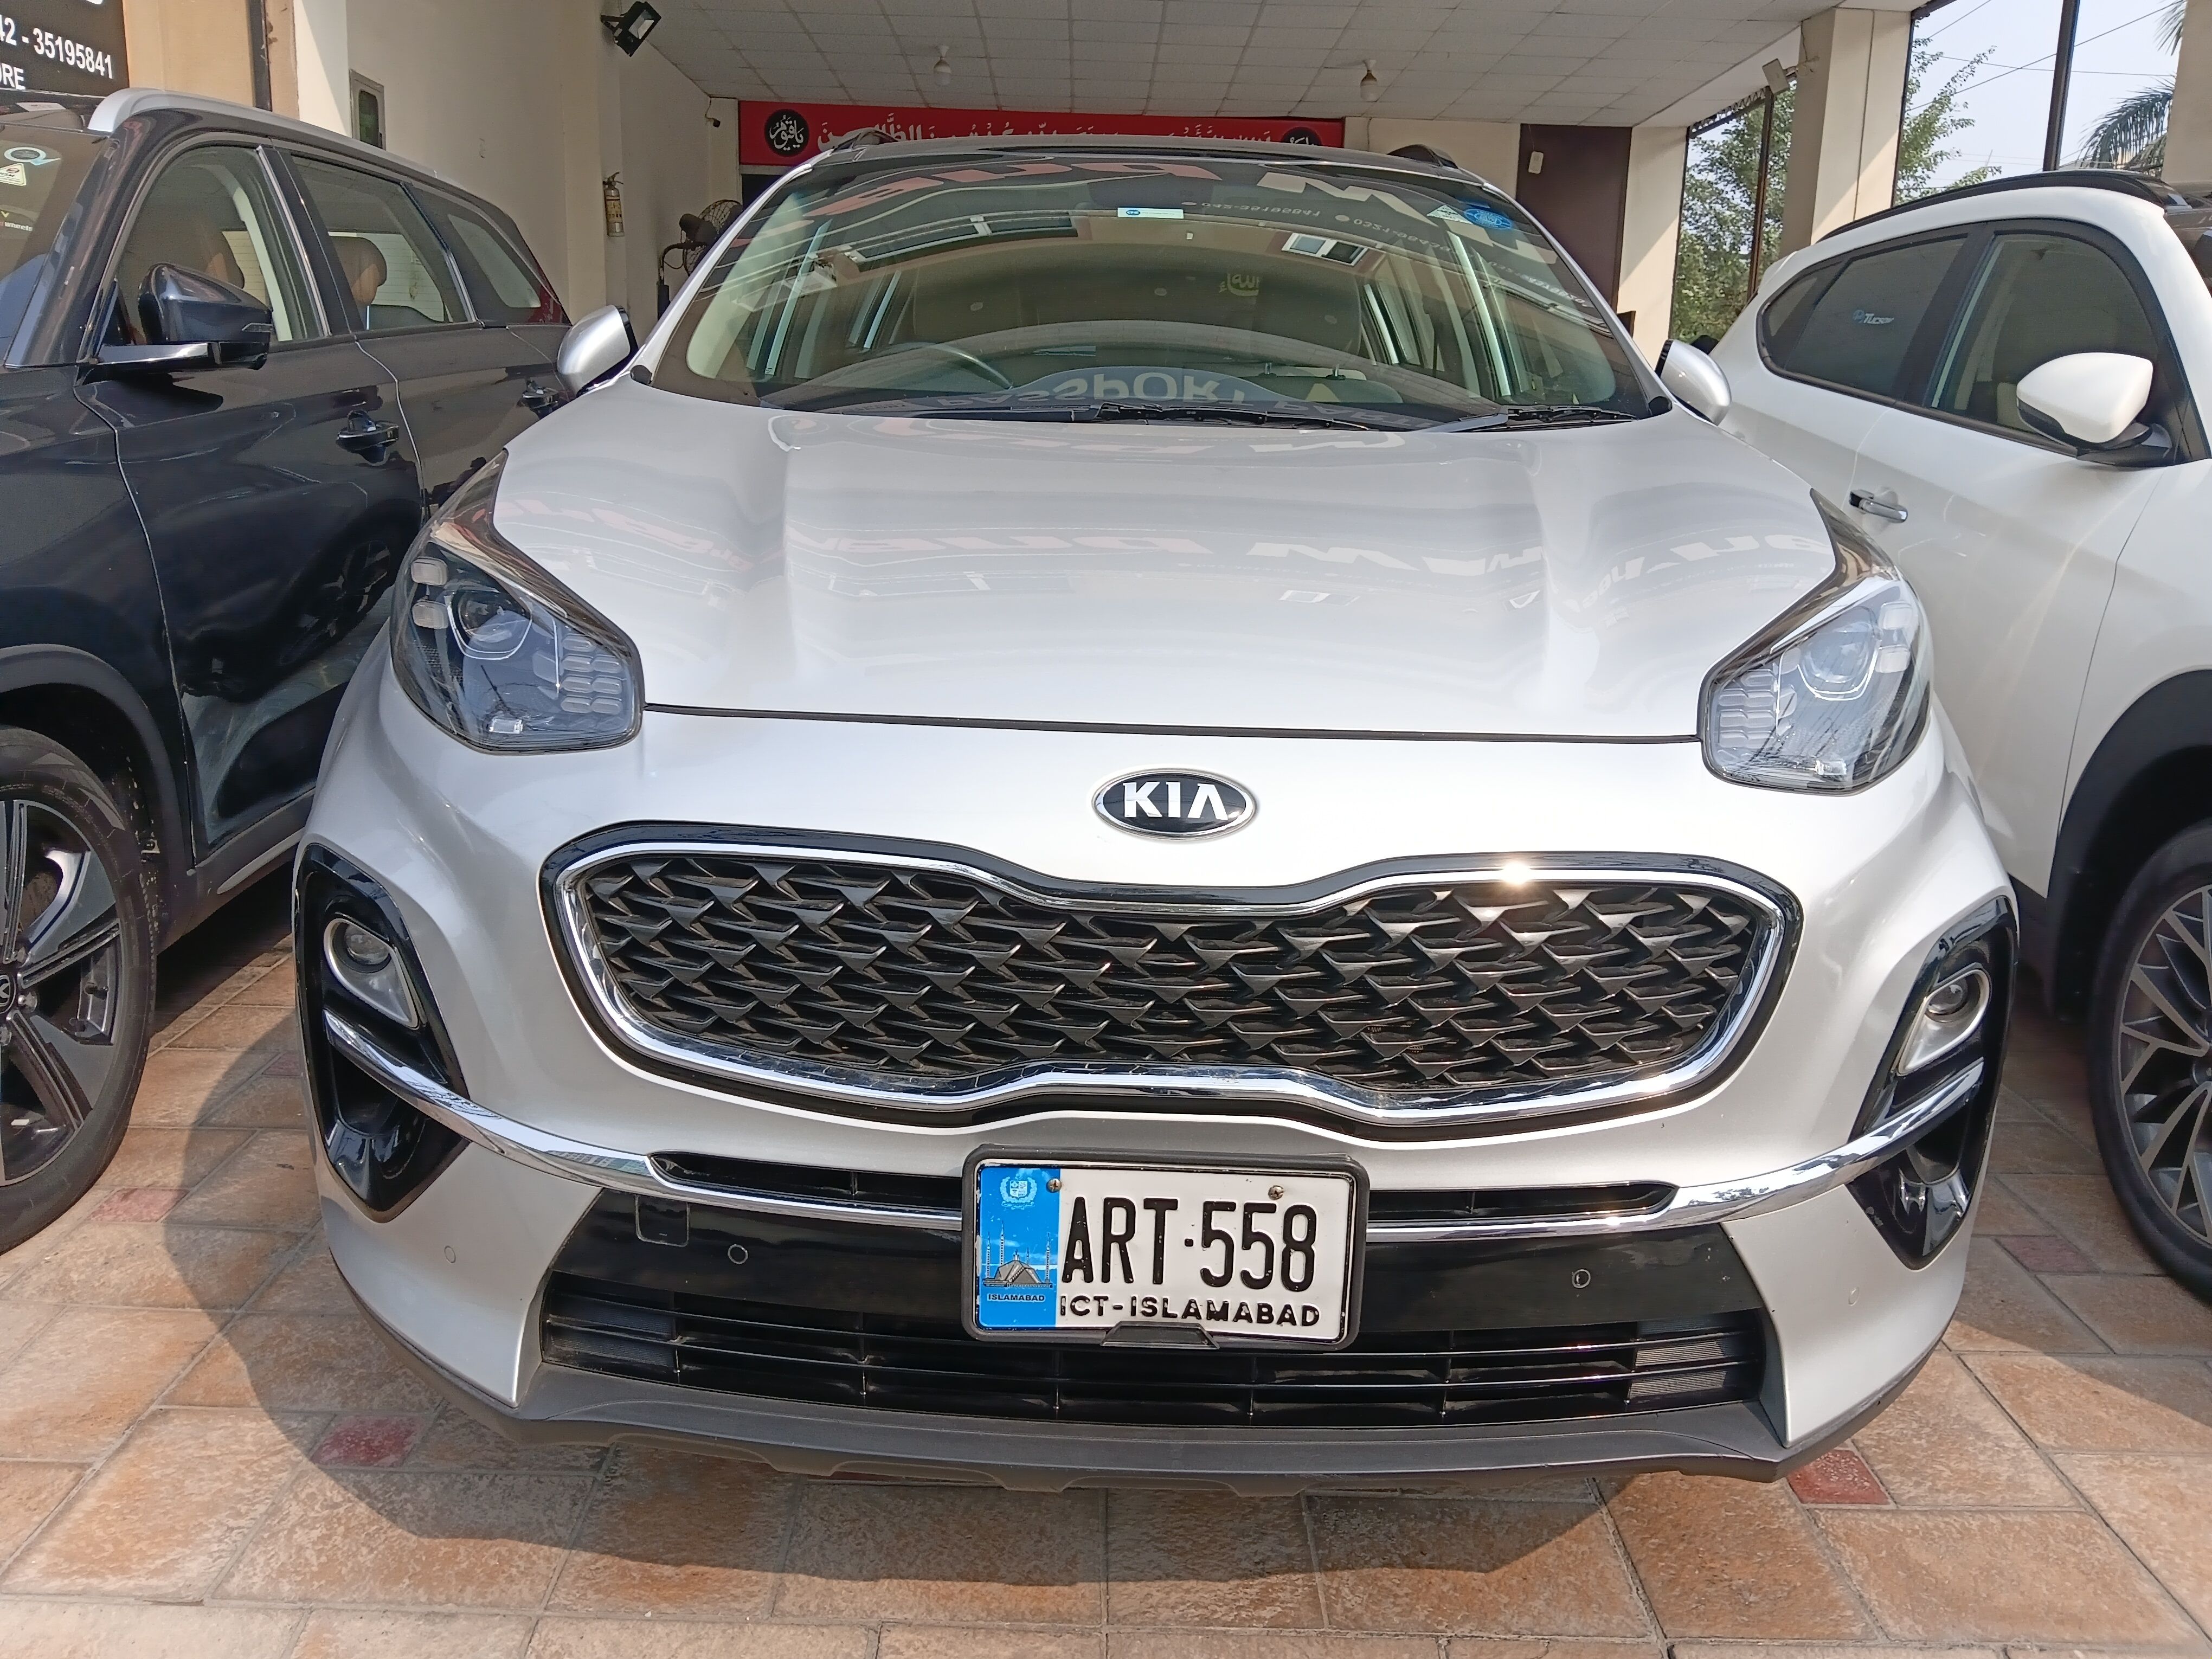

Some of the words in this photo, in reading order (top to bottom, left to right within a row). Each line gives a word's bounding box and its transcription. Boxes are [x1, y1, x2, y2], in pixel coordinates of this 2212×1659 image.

[33, 28, 113, 79] 35195841
[0, 62, 26, 90] RE
[1122, 781, 1229, 820] KIA
[988, 1294, 1045, 1302] ISLAMABAD
[1060, 1295, 1321, 1327] ICT-ISLAMABAD
